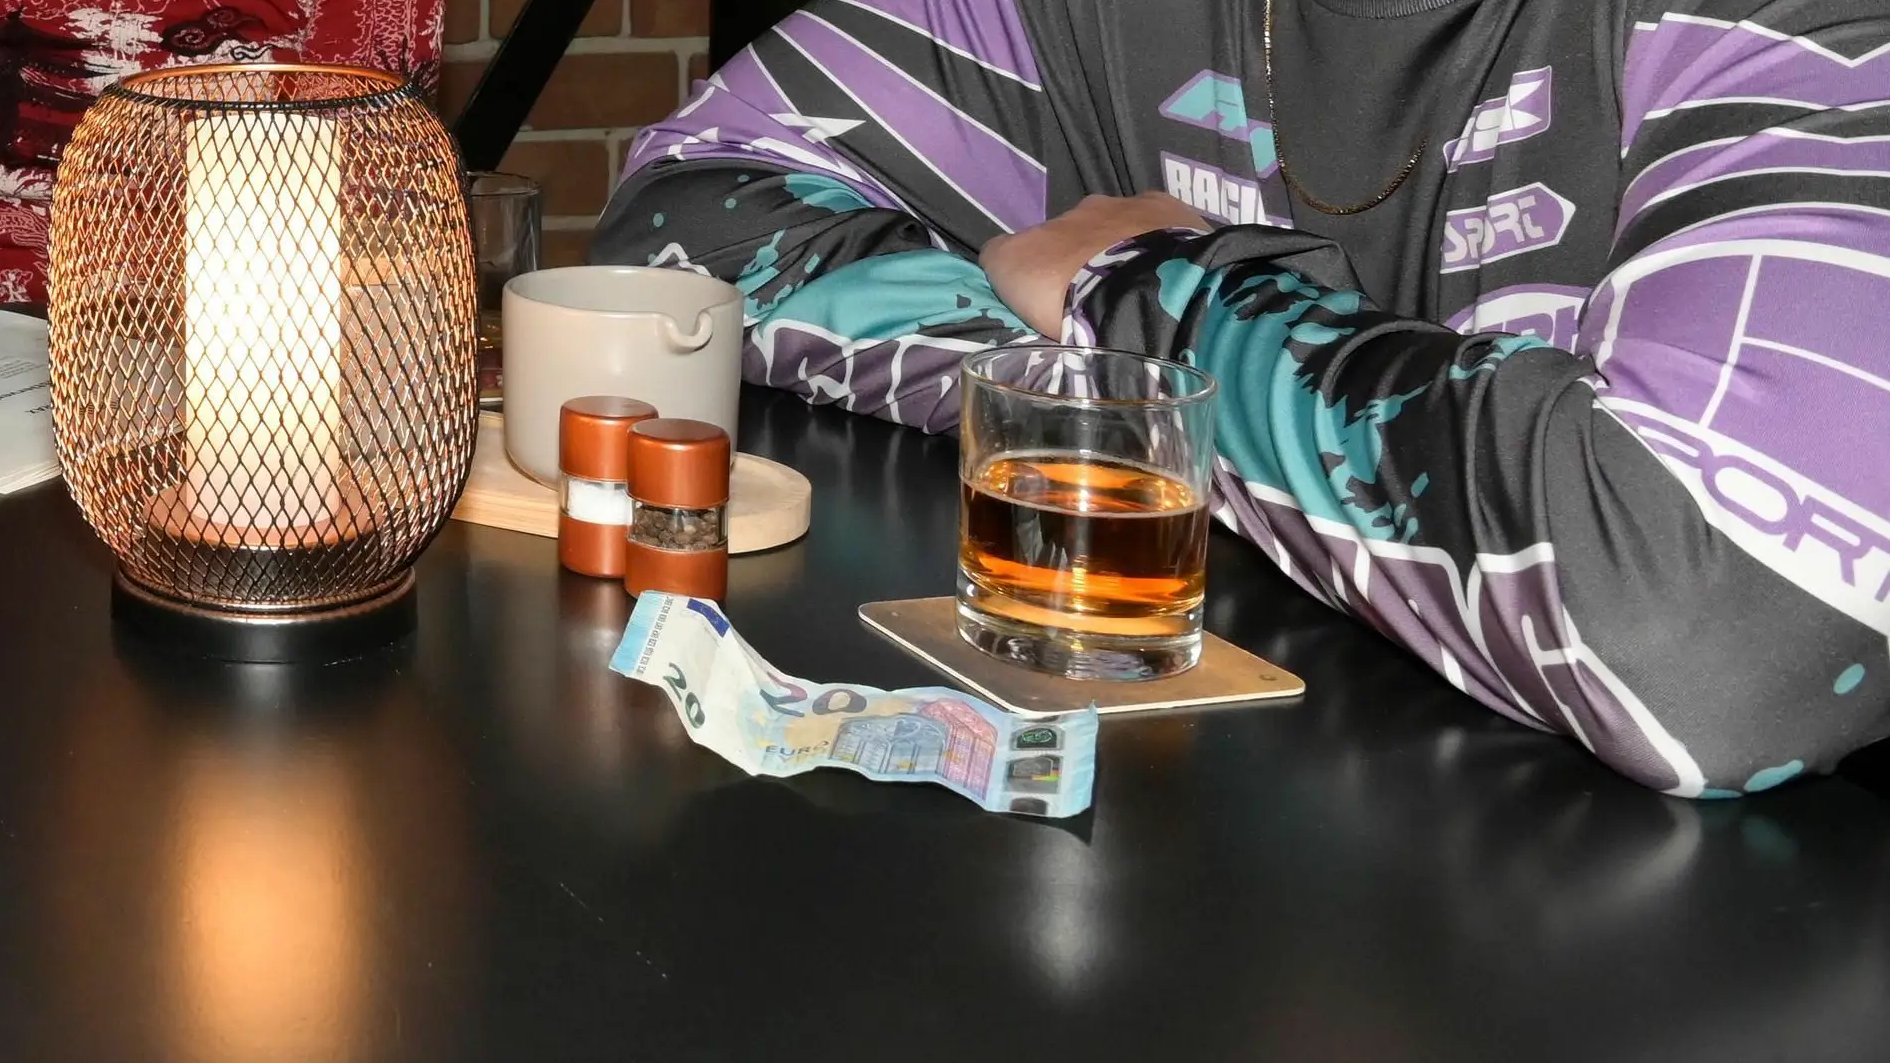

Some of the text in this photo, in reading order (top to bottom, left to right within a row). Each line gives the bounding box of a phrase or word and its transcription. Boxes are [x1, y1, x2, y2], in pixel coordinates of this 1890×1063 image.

[1165, 158, 1294, 229] RACI
[663, 662, 706, 729] 20
[759, 671, 868, 718] 20
[765, 740, 830, 756] EURO
